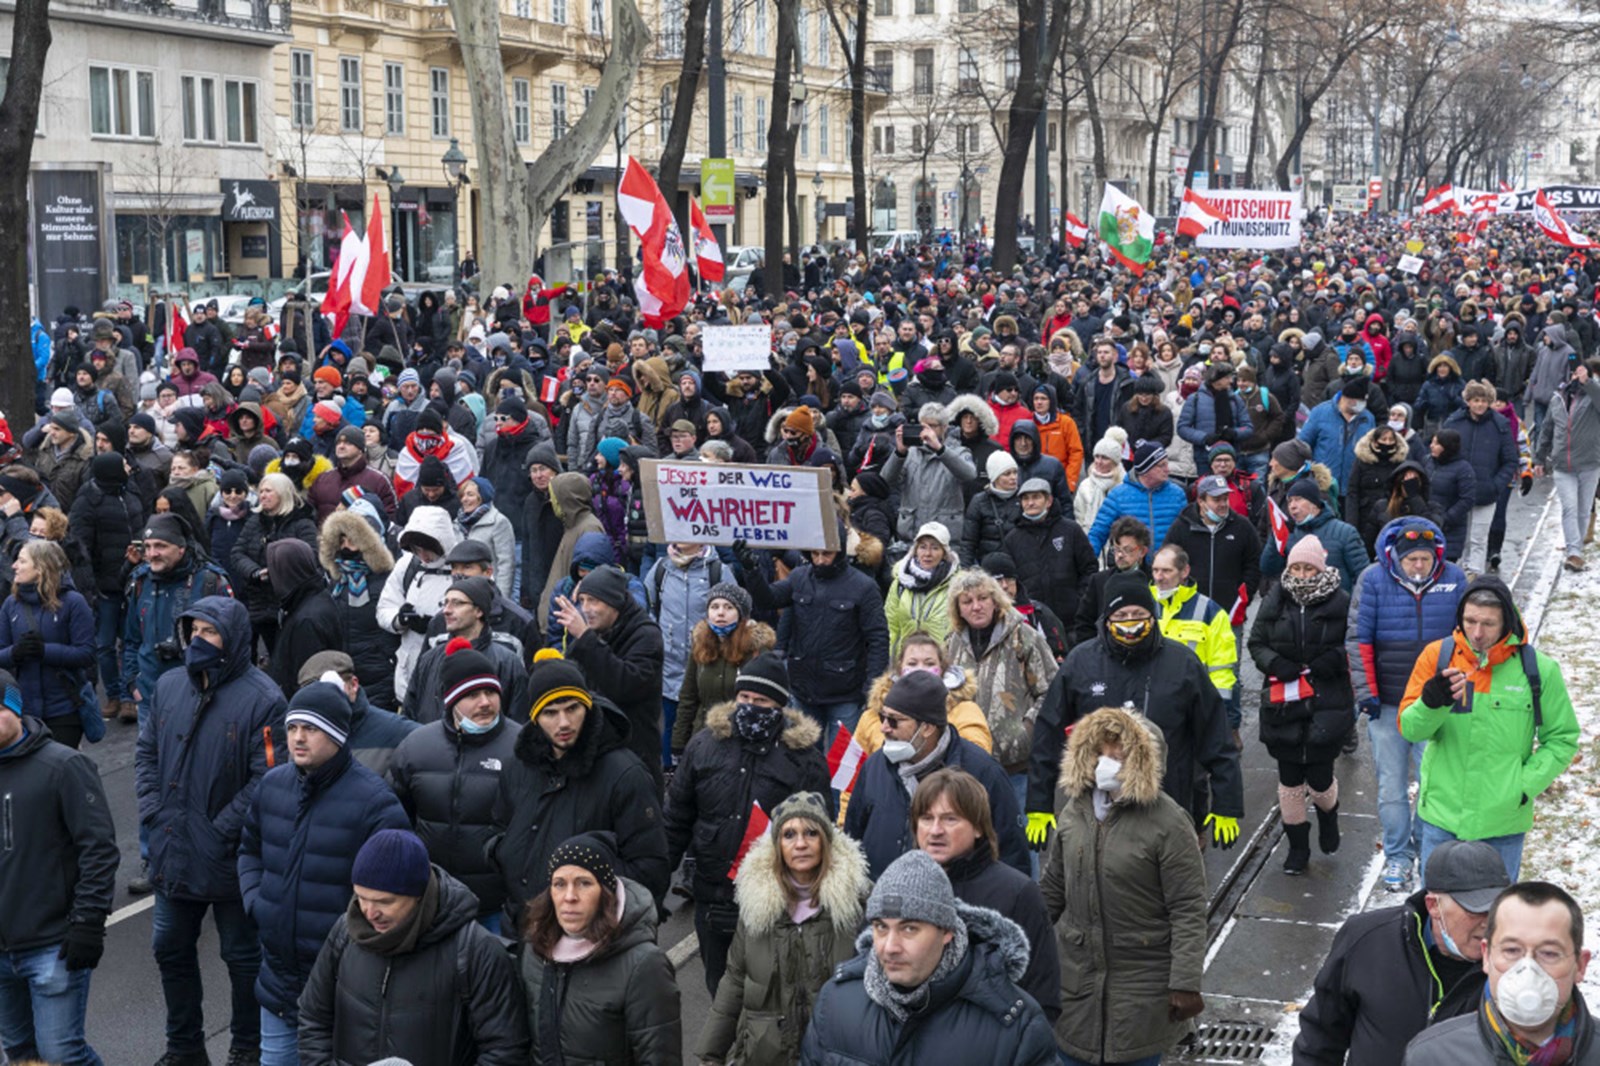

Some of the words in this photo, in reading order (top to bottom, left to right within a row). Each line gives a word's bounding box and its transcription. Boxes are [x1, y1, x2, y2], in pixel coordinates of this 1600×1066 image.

[57, 195, 82, 204] Ohne
[1463, 193, 1511, 207] KZ
[1577, 190, 1600, 204] W
[45, 204, 74, 214] Kultur
[76, 204, 94, 214] sind
[1221, 221, 1290, 236] MUNDSCHUTZ
[718, 472, 745, 485] DER
[749, 471, 792, 489] WEG
[680, 487, 698, 498] DIE
[667, 497, 796, 527] WAHRHEIT
[692, 524, 720, 537] DAS
[733, 527, 788, 541] LEBEN
